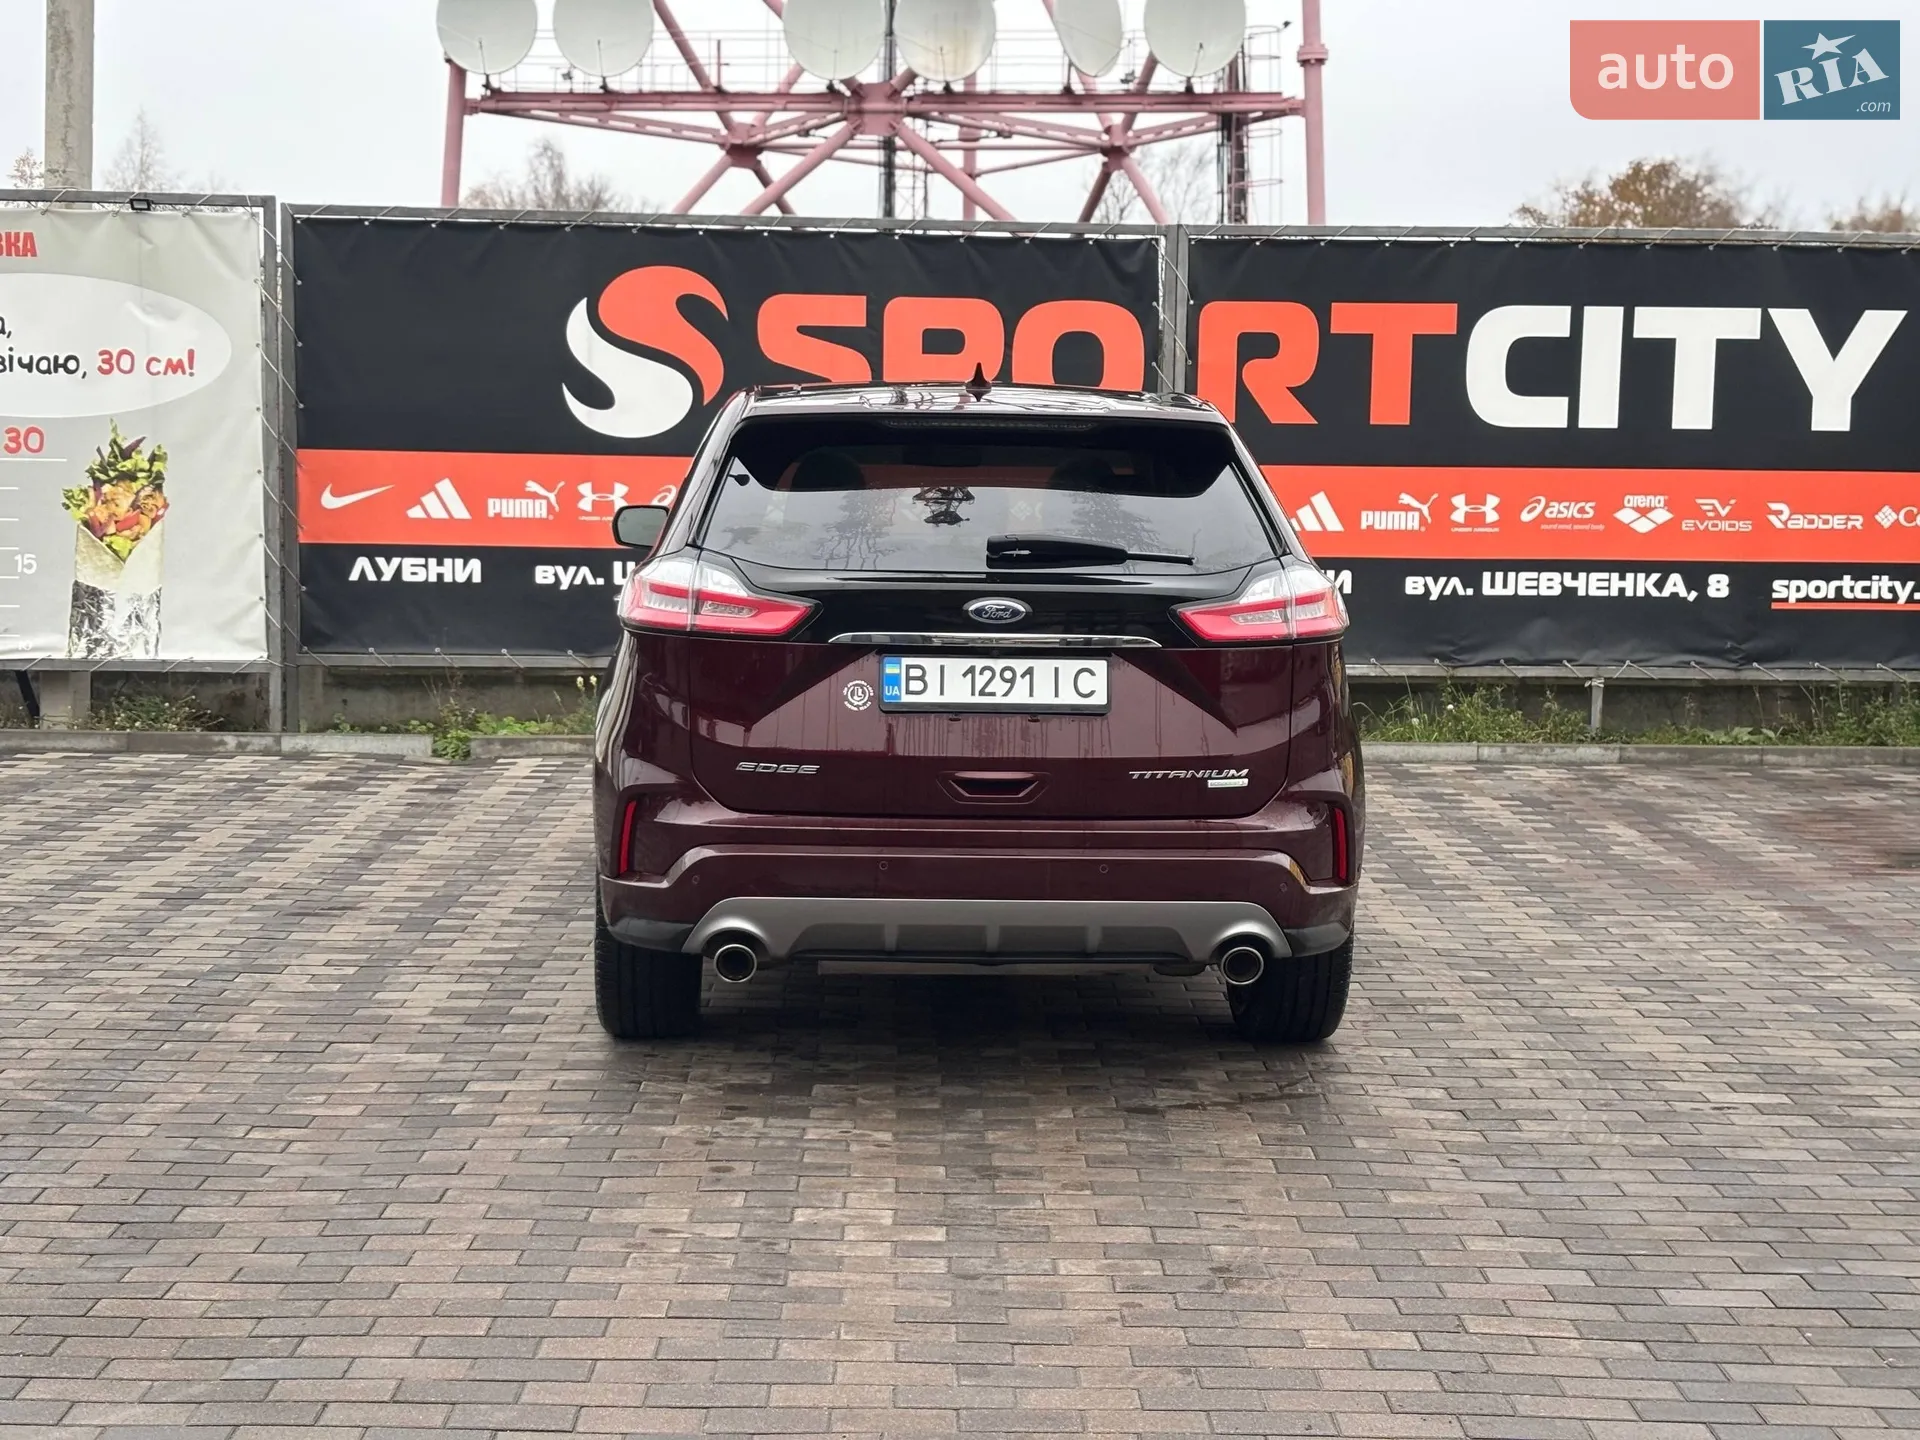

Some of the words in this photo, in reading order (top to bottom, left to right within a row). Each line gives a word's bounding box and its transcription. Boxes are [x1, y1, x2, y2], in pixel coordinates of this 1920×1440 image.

[96, 348, 136, 376] 30
[145, 348, 196, 377] см!
[3, 426, 45, 455] 30
[487, 497, 549, 519] PUMA
[1623, 494, 1665, 508] arena
[1359, 510, 1421, 531] PUMA
[1681, 519, 1753, 532] EVOIDS
[14, 552, 38, 575] 15
[348, 556, 482, 584] ЛУБНИ
[534, 564, 605, 591] вул.
[1404, 575, 1474, 601] вул.
[1482, 571, 1699, 602] ШЕВЧЕНКА,
[1706, 573, 1730, 599] 8
[981, 604, 1012, 619] Ford
[885, 686, 900, 696] UA
[905, 663, 946, 697] BI
[961, 664, 1035, 698] 1291
[1054, 666, 1097, 699] IC
[735, 761, 821, 775] EDGE
[1128, 768, 1250, 779] TITANIUM
